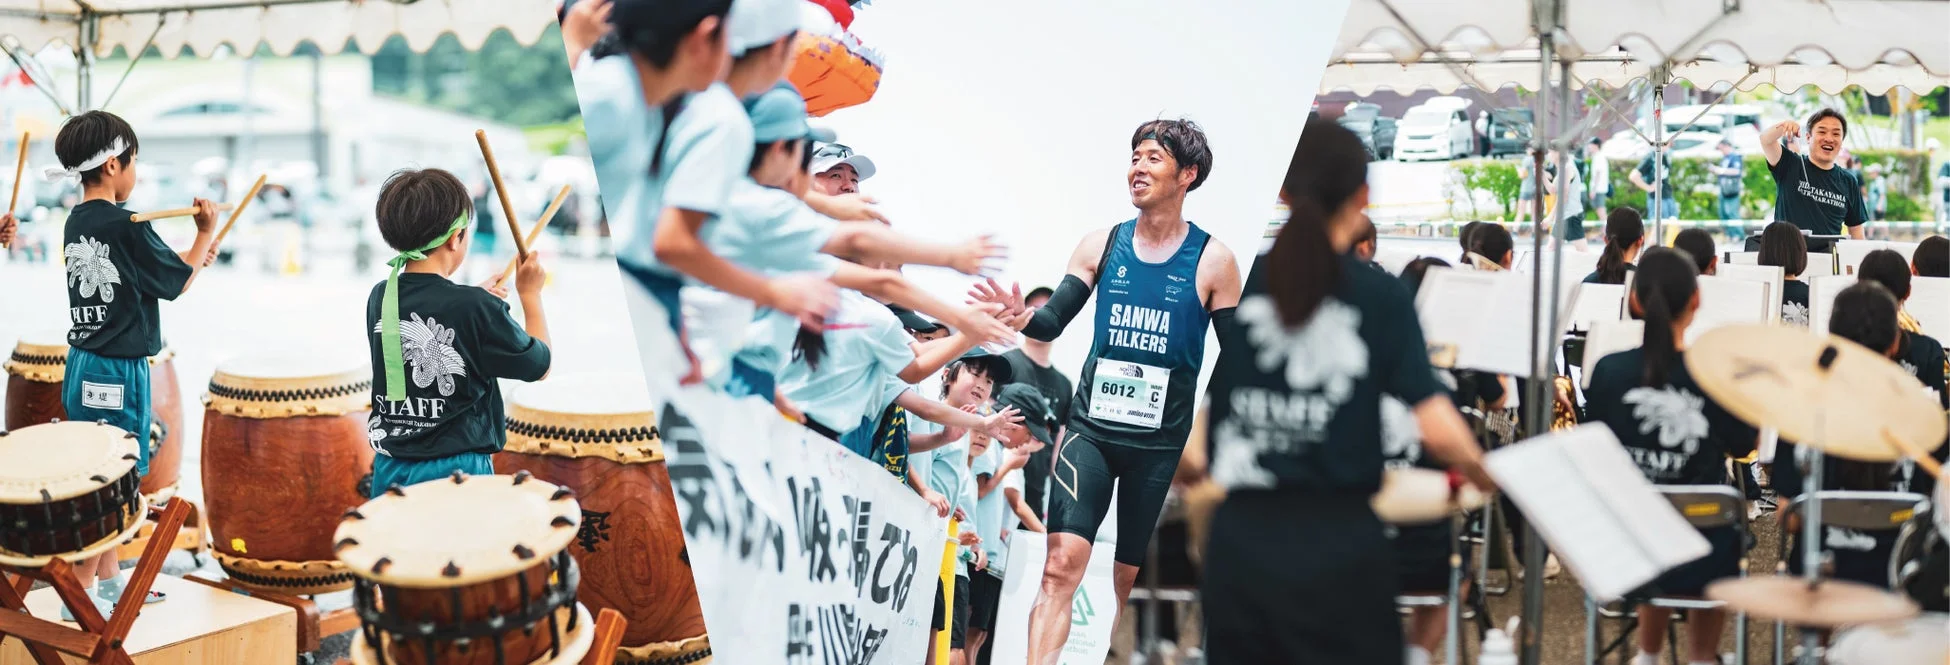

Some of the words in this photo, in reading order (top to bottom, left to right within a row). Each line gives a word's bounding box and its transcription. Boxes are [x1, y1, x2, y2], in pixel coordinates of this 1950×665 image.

[70, 305, 108, 323] TAFF
[1109, 303, 1170, 334] SANWA
[1108, 328, 1168, 354] TALKERS
[1101, 381, 1135, 398] 6012
[1151, 391, 1159, 403] C
[375, 394, 446, 419] STAFF
